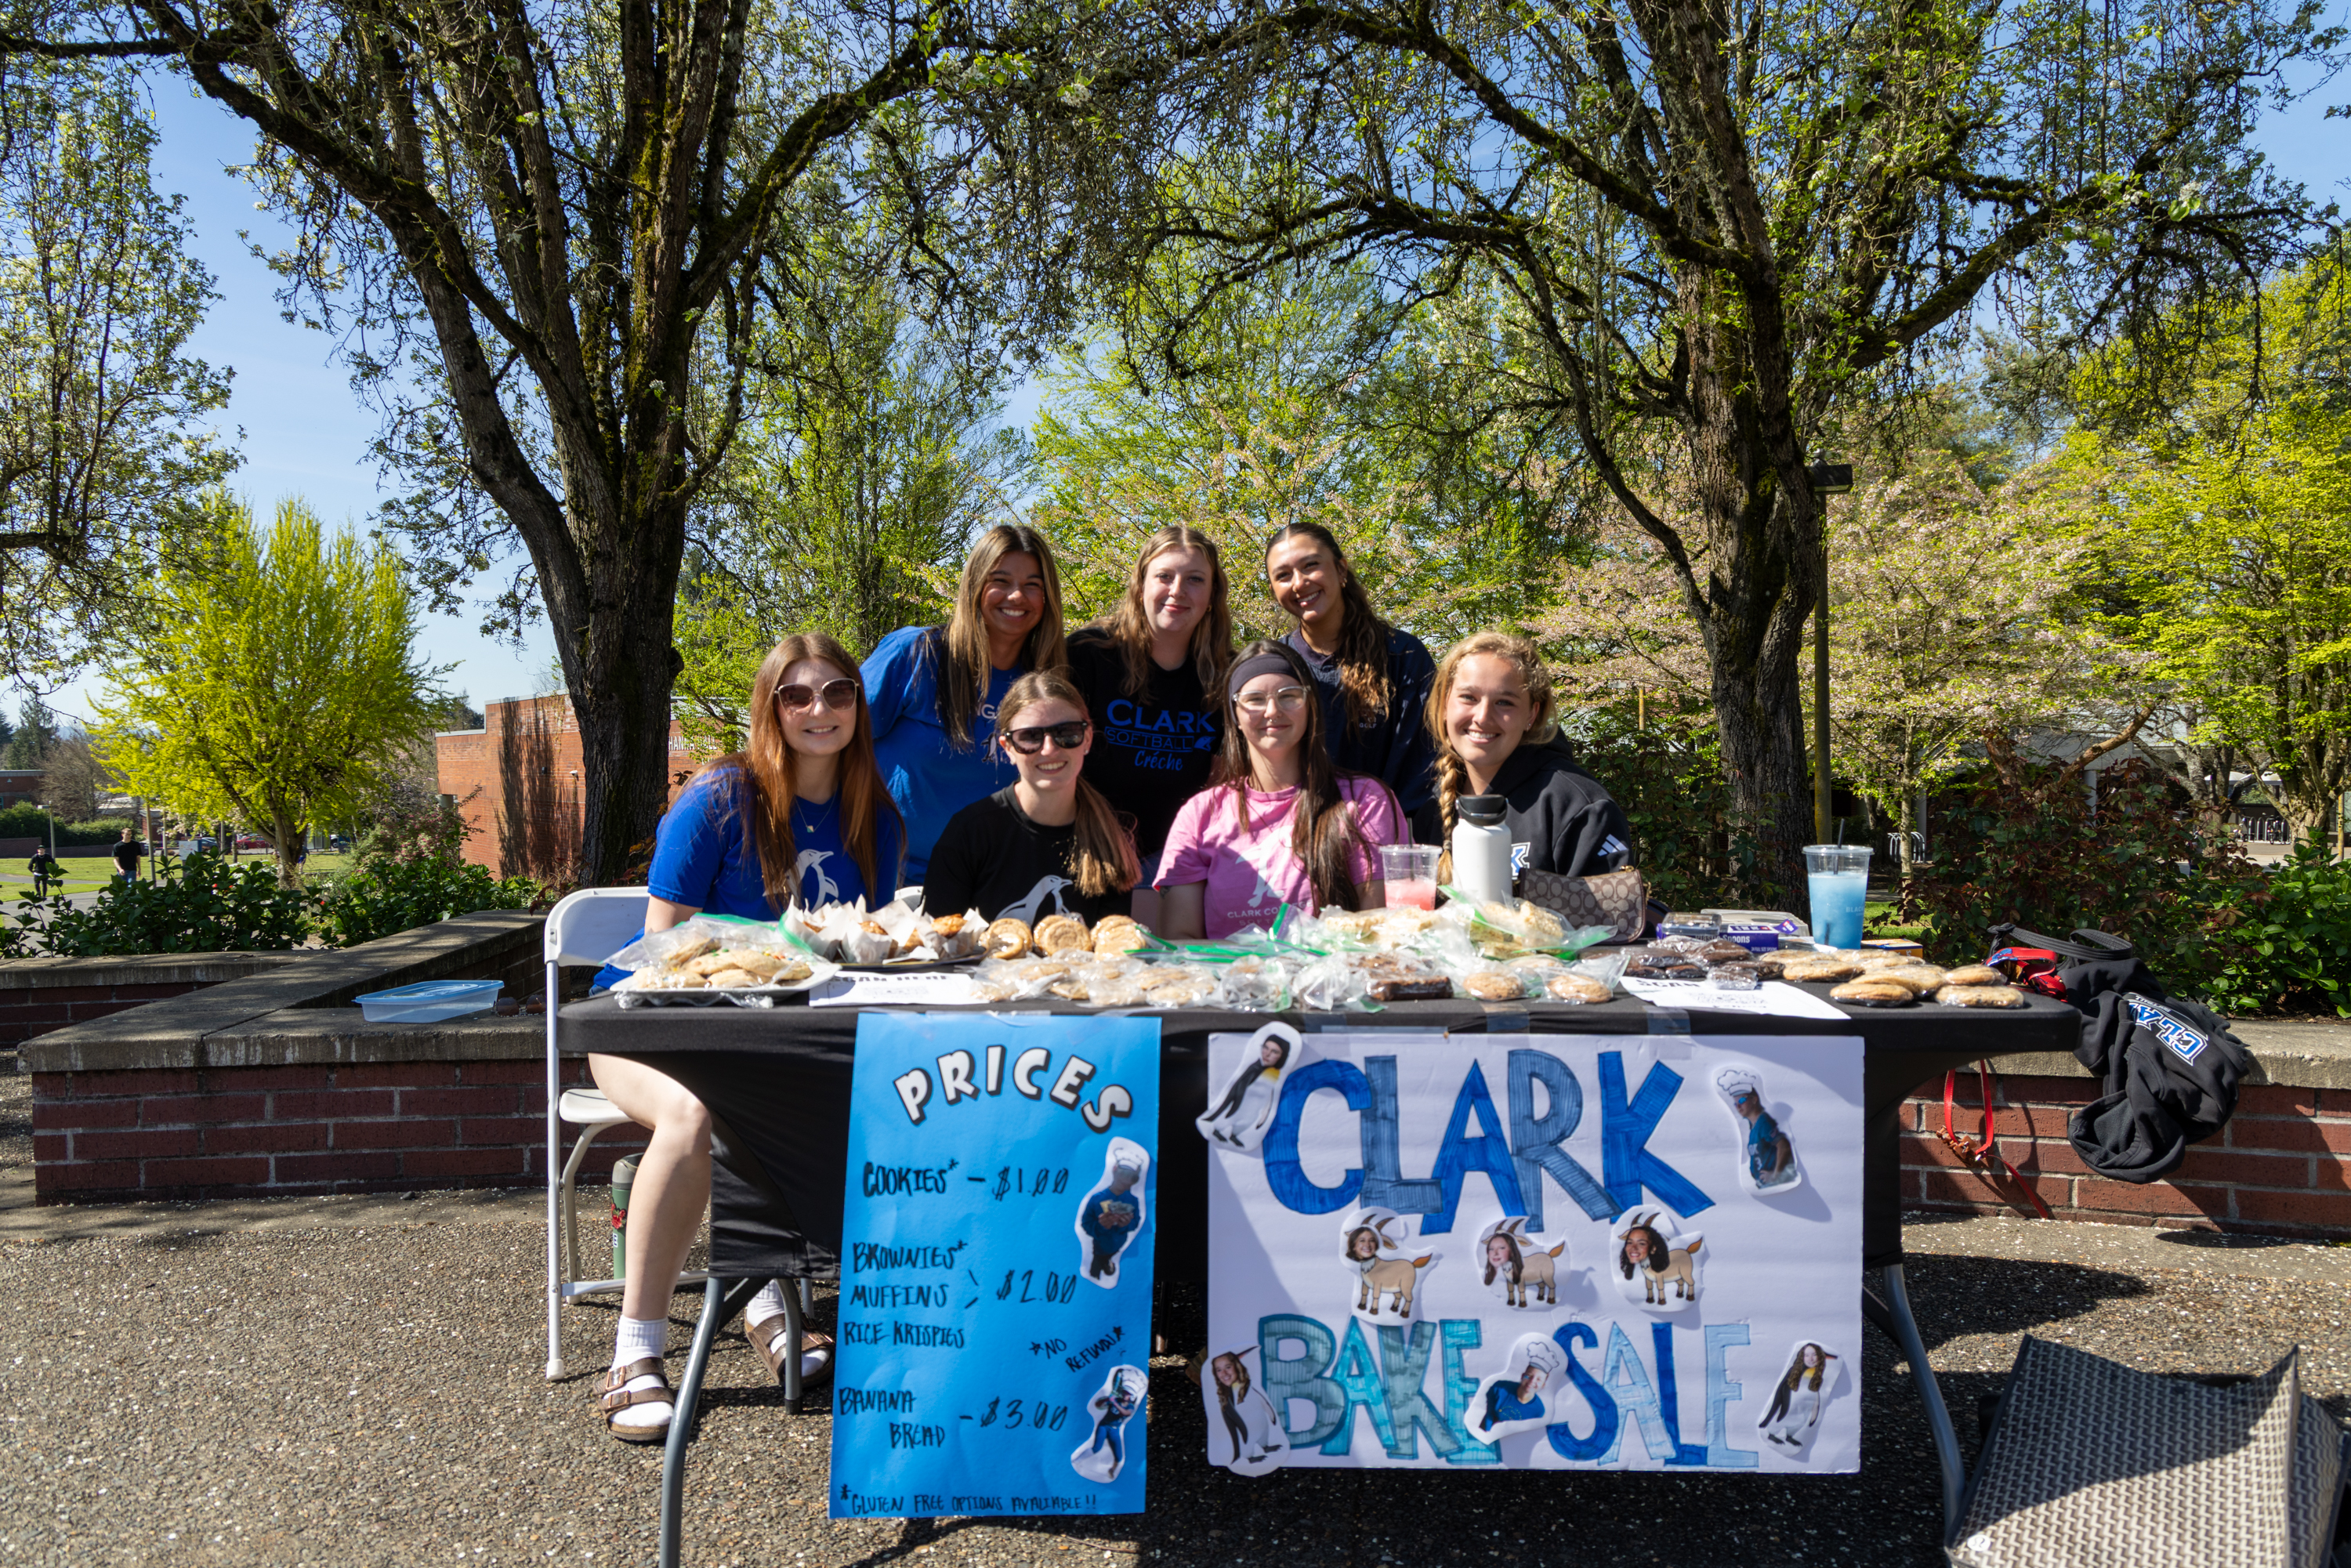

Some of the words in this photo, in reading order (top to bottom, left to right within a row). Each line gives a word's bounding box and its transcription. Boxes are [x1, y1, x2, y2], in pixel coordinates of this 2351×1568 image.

[1107, 699, 1215, 733] CLARK
[1107, 729, 1193, 750] SOFTBALL
[1134, 750, 1183, 771] Créche
[1227, 909, 1262, 918] CLARK
[1724, 934, 1751, 944] Spoons
[2128, 1001, 2205, 1061] CLA
[893, 1045, 1133, 1134] PRICES
[1262, 1048, 1716, 1235] CLARK
[849, 1284, 950, 1309] MUFFINS
[996, 1269, 1078, 1305] $2.00
[843, 1321, 890, 1346] RICE
[893, 1320, 965, 1349] KRISPIES
[838, 1387, 917, 1415] BANANA
[1258, 1314, 1502, 1465] BAKE
[1545, 1321, 1759, 1468] SALE
[889, 1422, 945, 1449] BREAD
[914, 1494, 945, 1513] FREE
[951, 1494, 1003, 1512] OPTIONS
